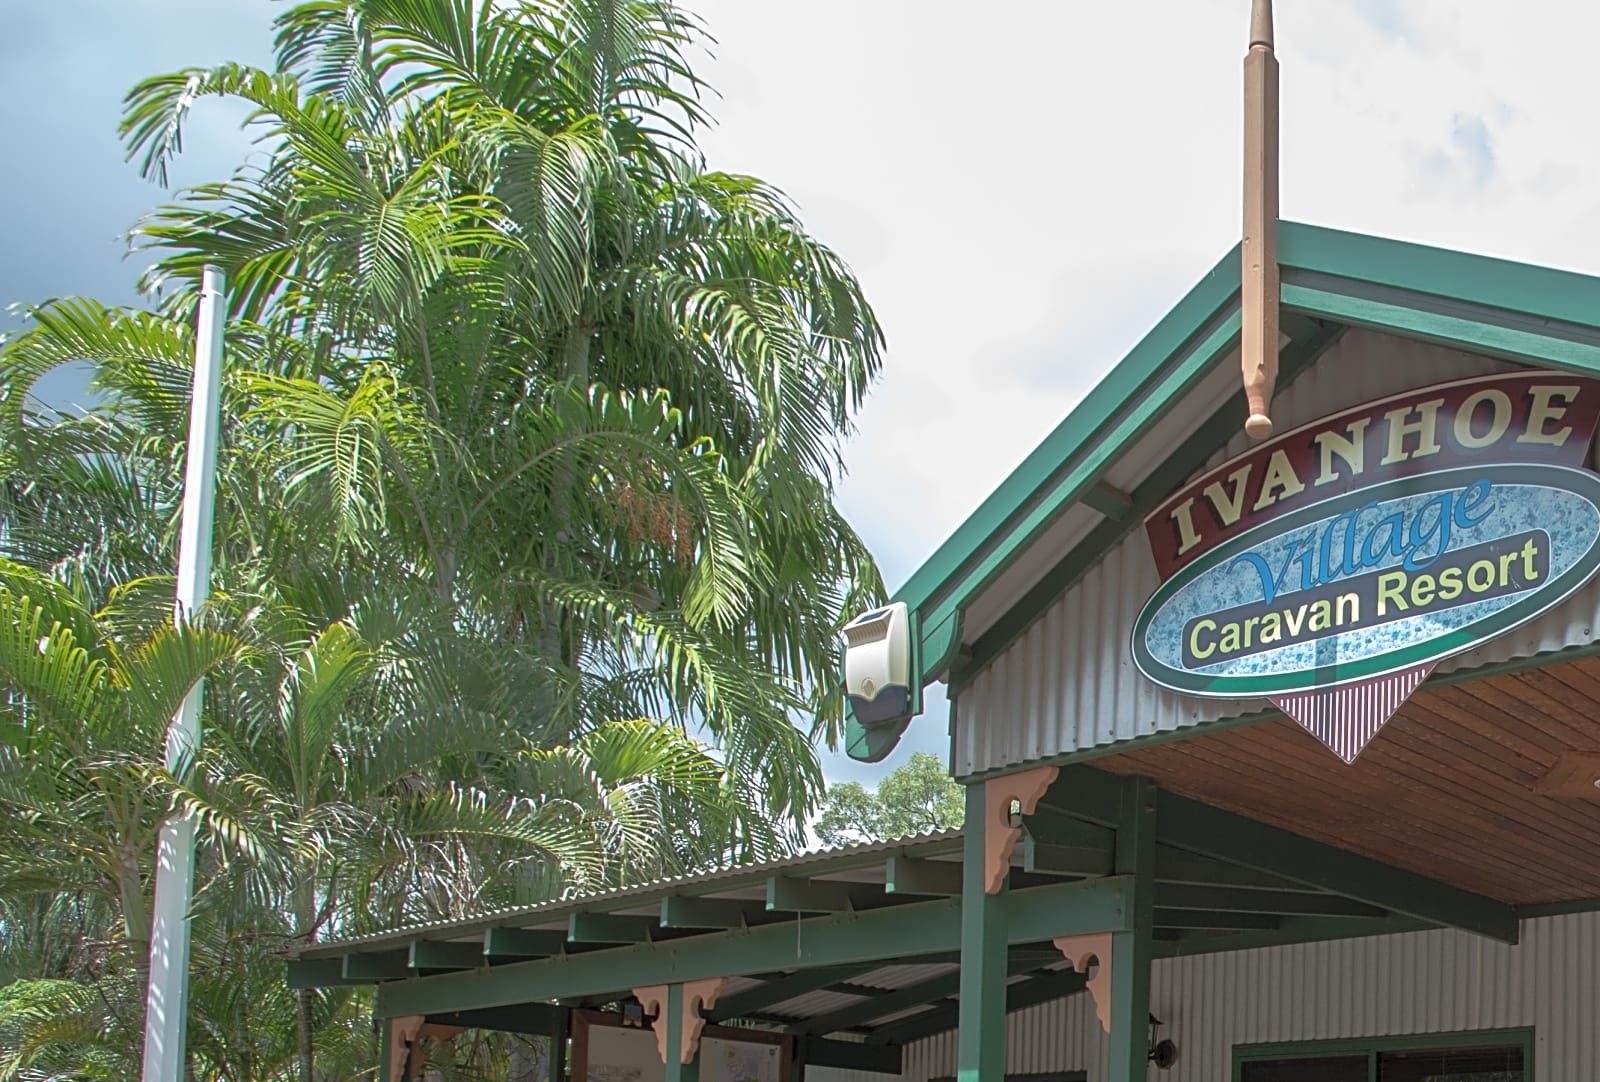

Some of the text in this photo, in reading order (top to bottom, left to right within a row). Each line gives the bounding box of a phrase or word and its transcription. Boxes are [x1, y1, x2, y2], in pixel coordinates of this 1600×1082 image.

[1170, 385, 1581, 557] IVANHOE
[1188, 537, 1540, 660] Caravan Resort
[1229, 479, 1496, 606] Village
